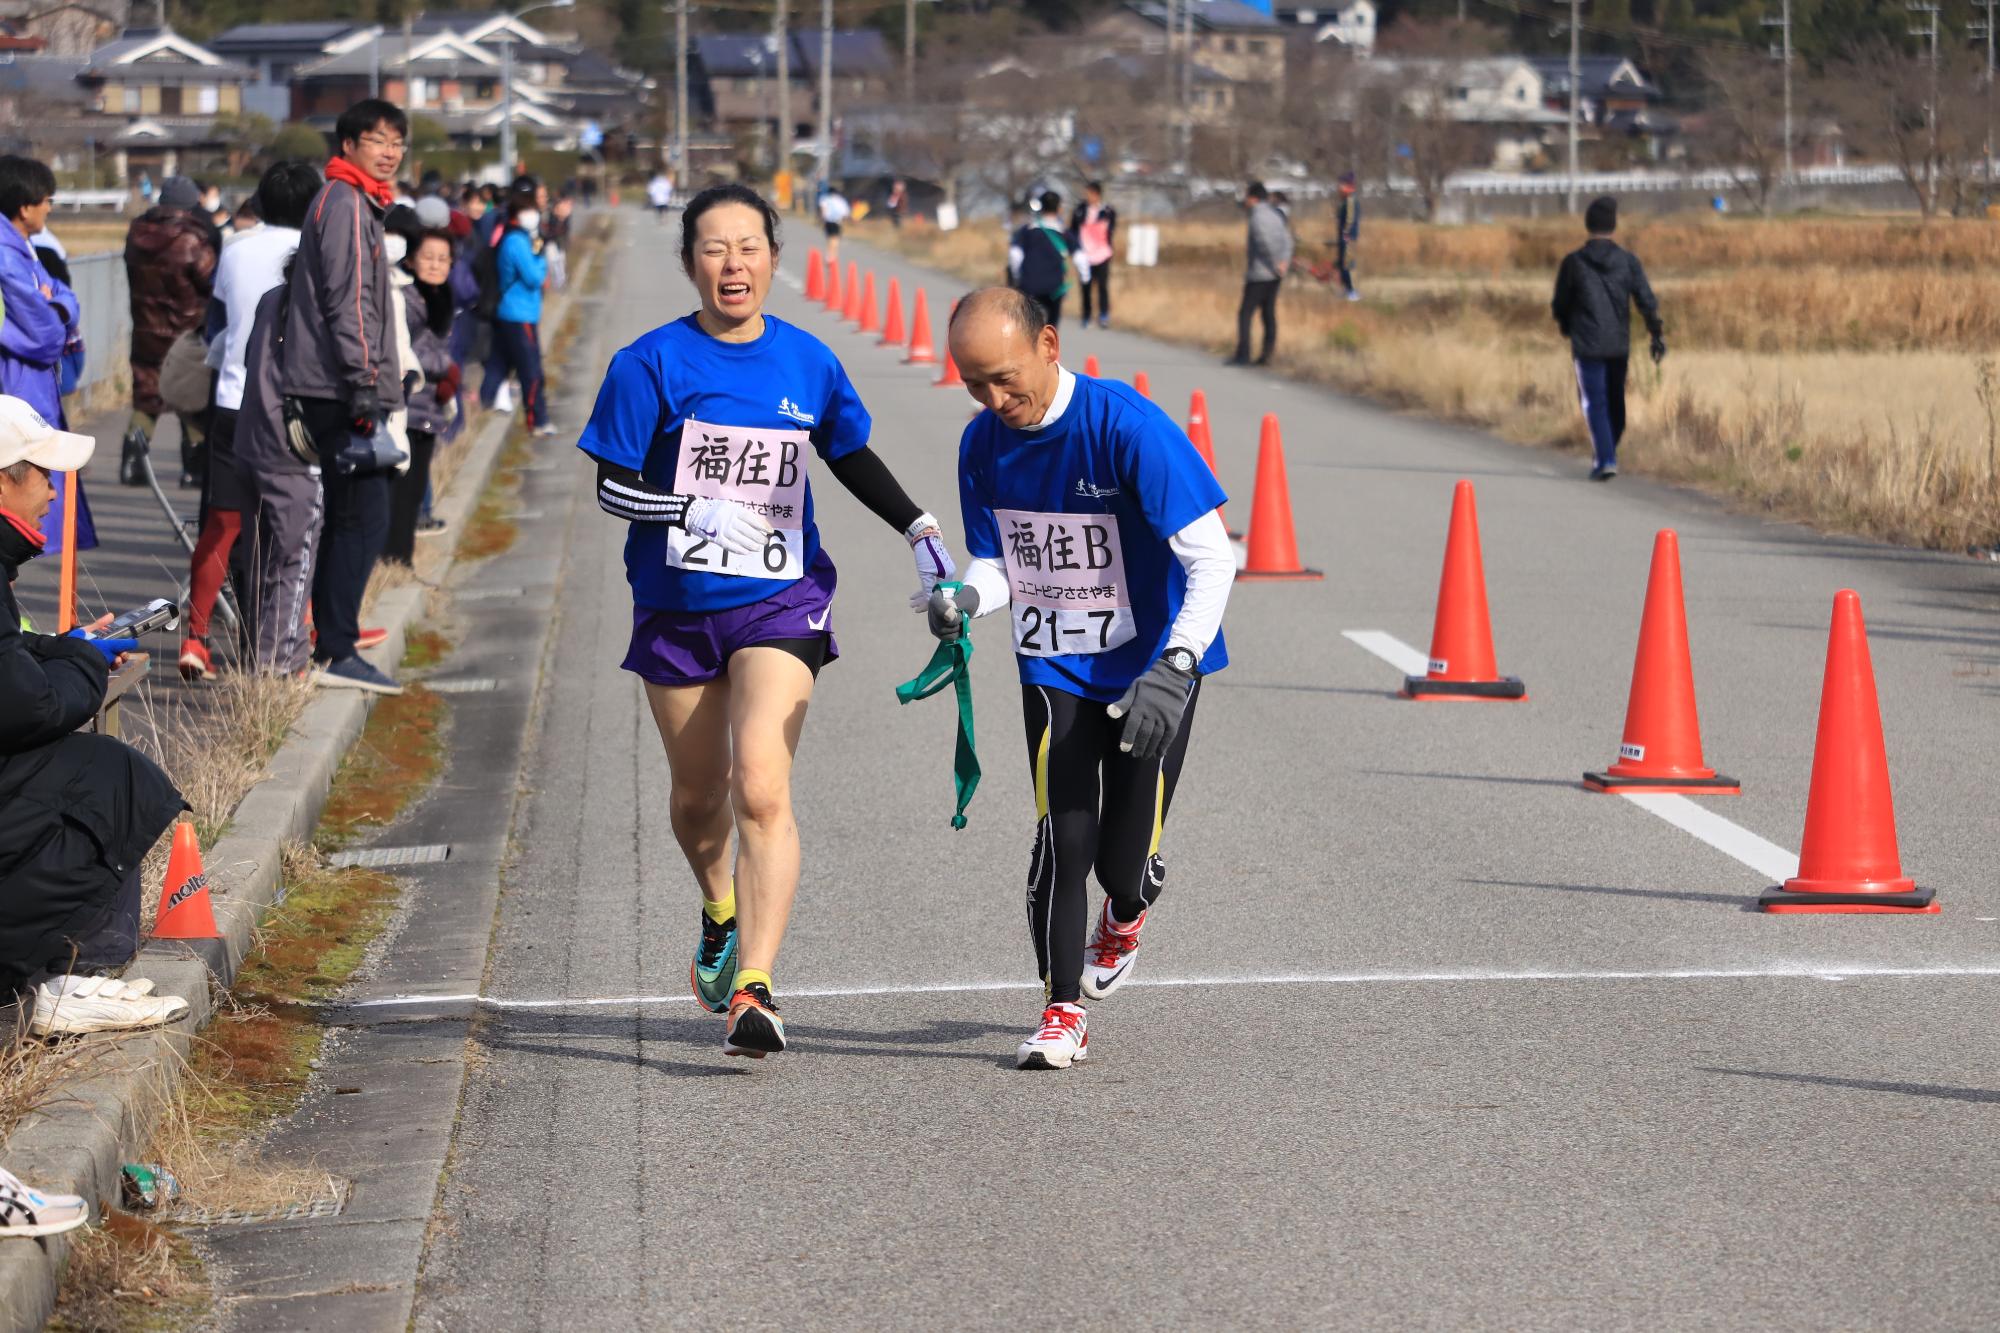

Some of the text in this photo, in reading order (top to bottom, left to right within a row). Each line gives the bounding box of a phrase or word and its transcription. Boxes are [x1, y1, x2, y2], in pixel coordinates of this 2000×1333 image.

[688, 434, 799, 488] 福住B
[1008, 520, 1113, 573] 福住B
[1018, 580, 1116, 600] ユニトピアささやま
[1020, 605, 1115, 652] 21-7
